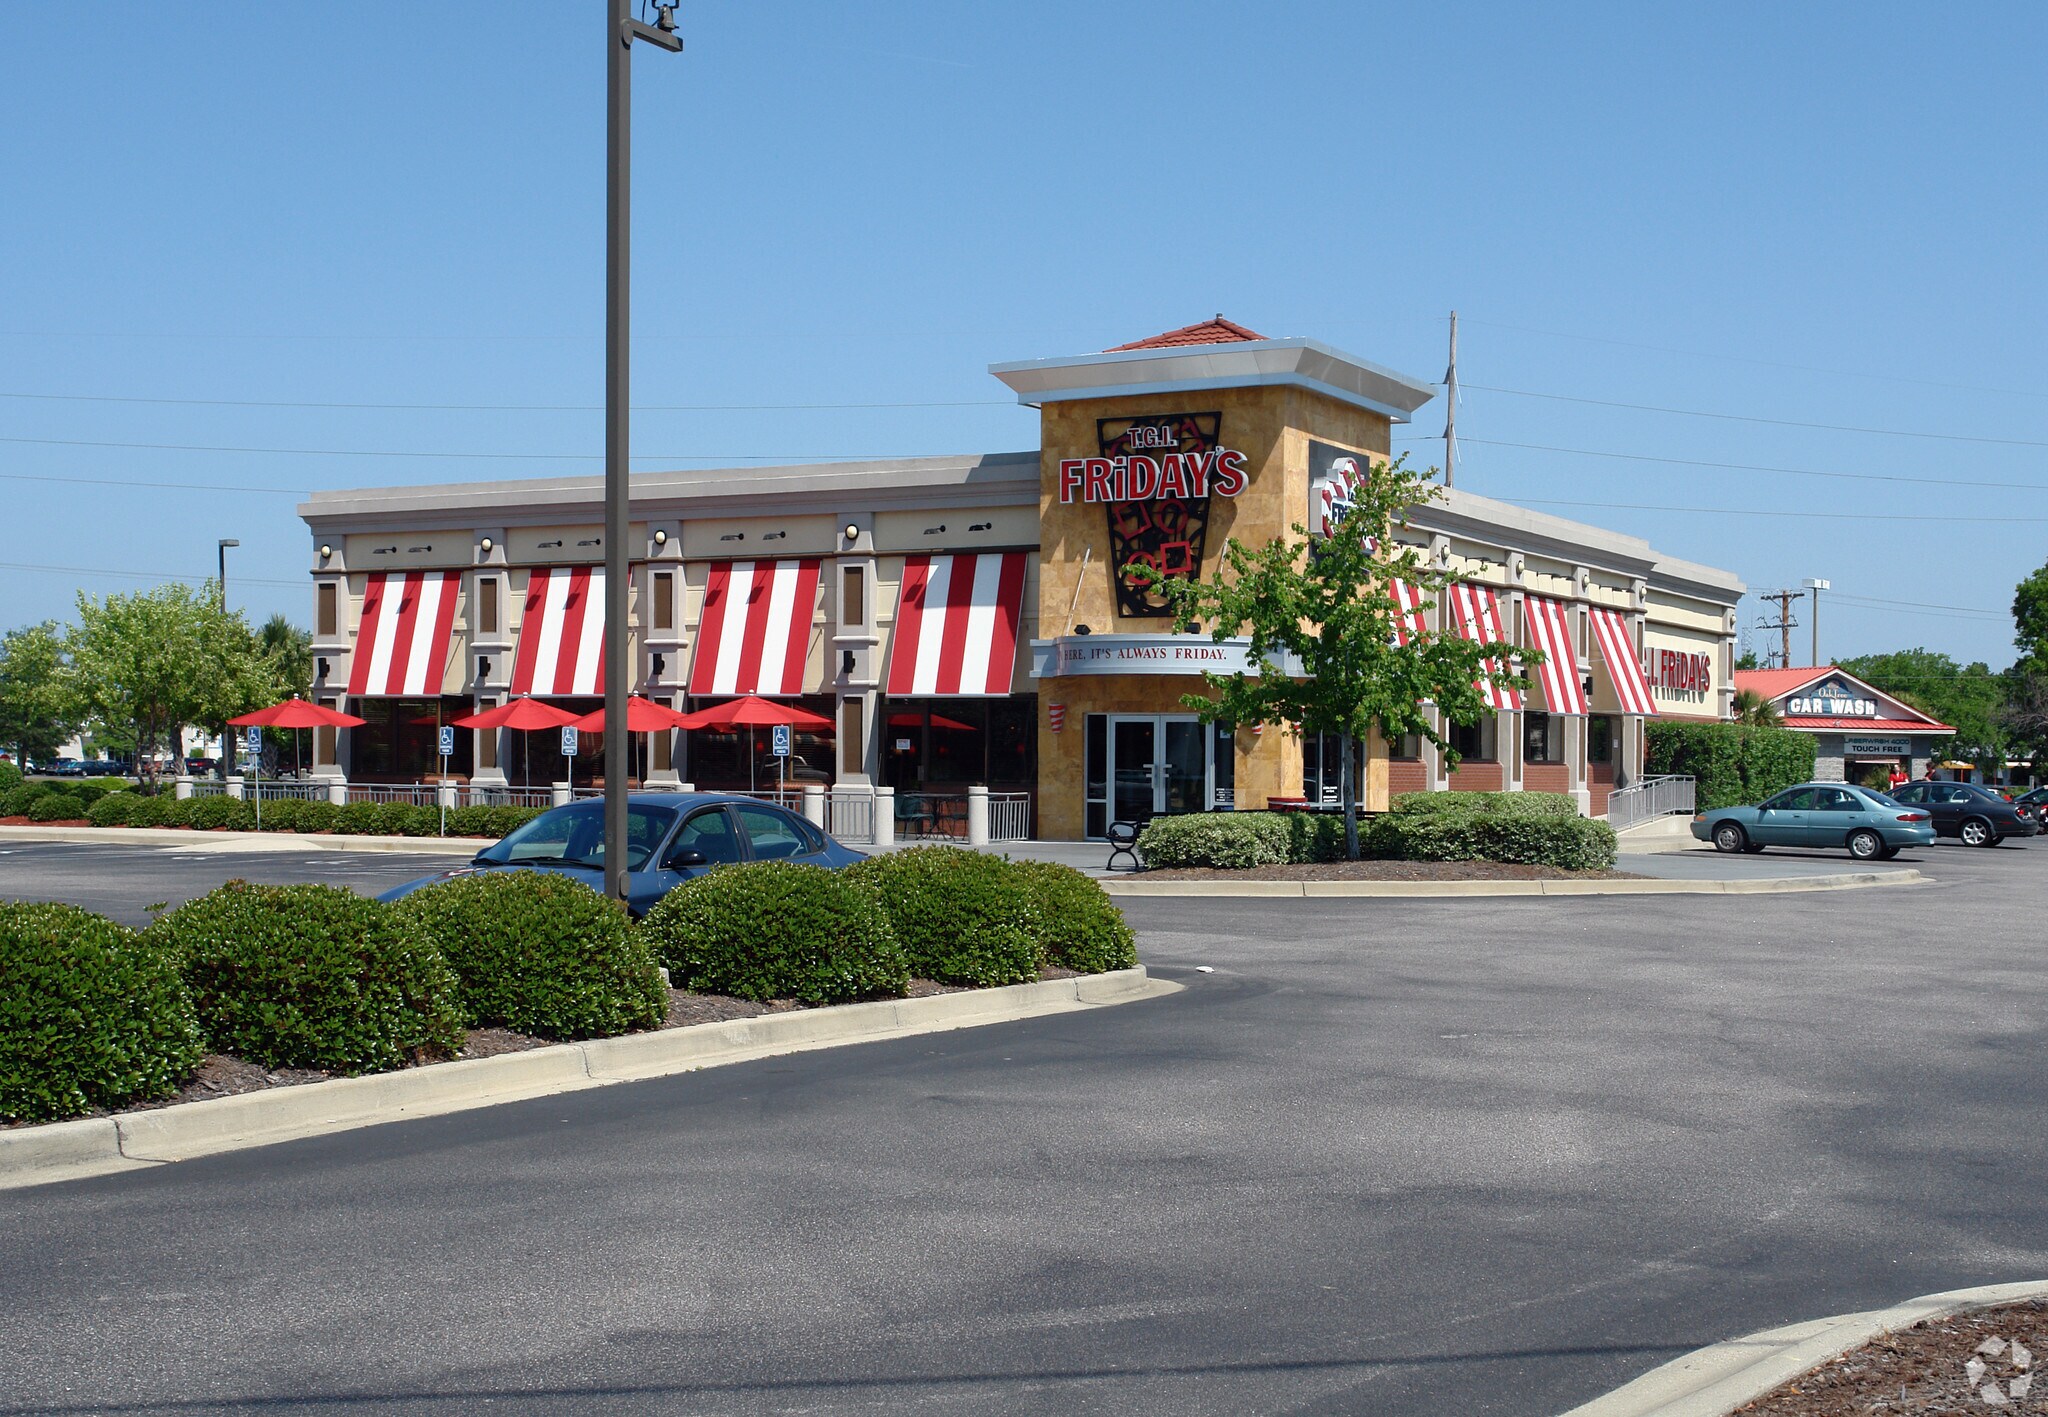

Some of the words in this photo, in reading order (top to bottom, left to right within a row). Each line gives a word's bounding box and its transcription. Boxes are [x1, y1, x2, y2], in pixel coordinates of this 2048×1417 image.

[1127, 425, 1178, 449] T.G.I.
[1091, 647, 1111, 660] IT'S
[1117, 647, 1167, 660] ALWAYS
[1175, 647, 1227, 660] FRIDAY.
[1790, 698, 1823, 714] CAR
[1830, 698, 1875, 715] WASH
